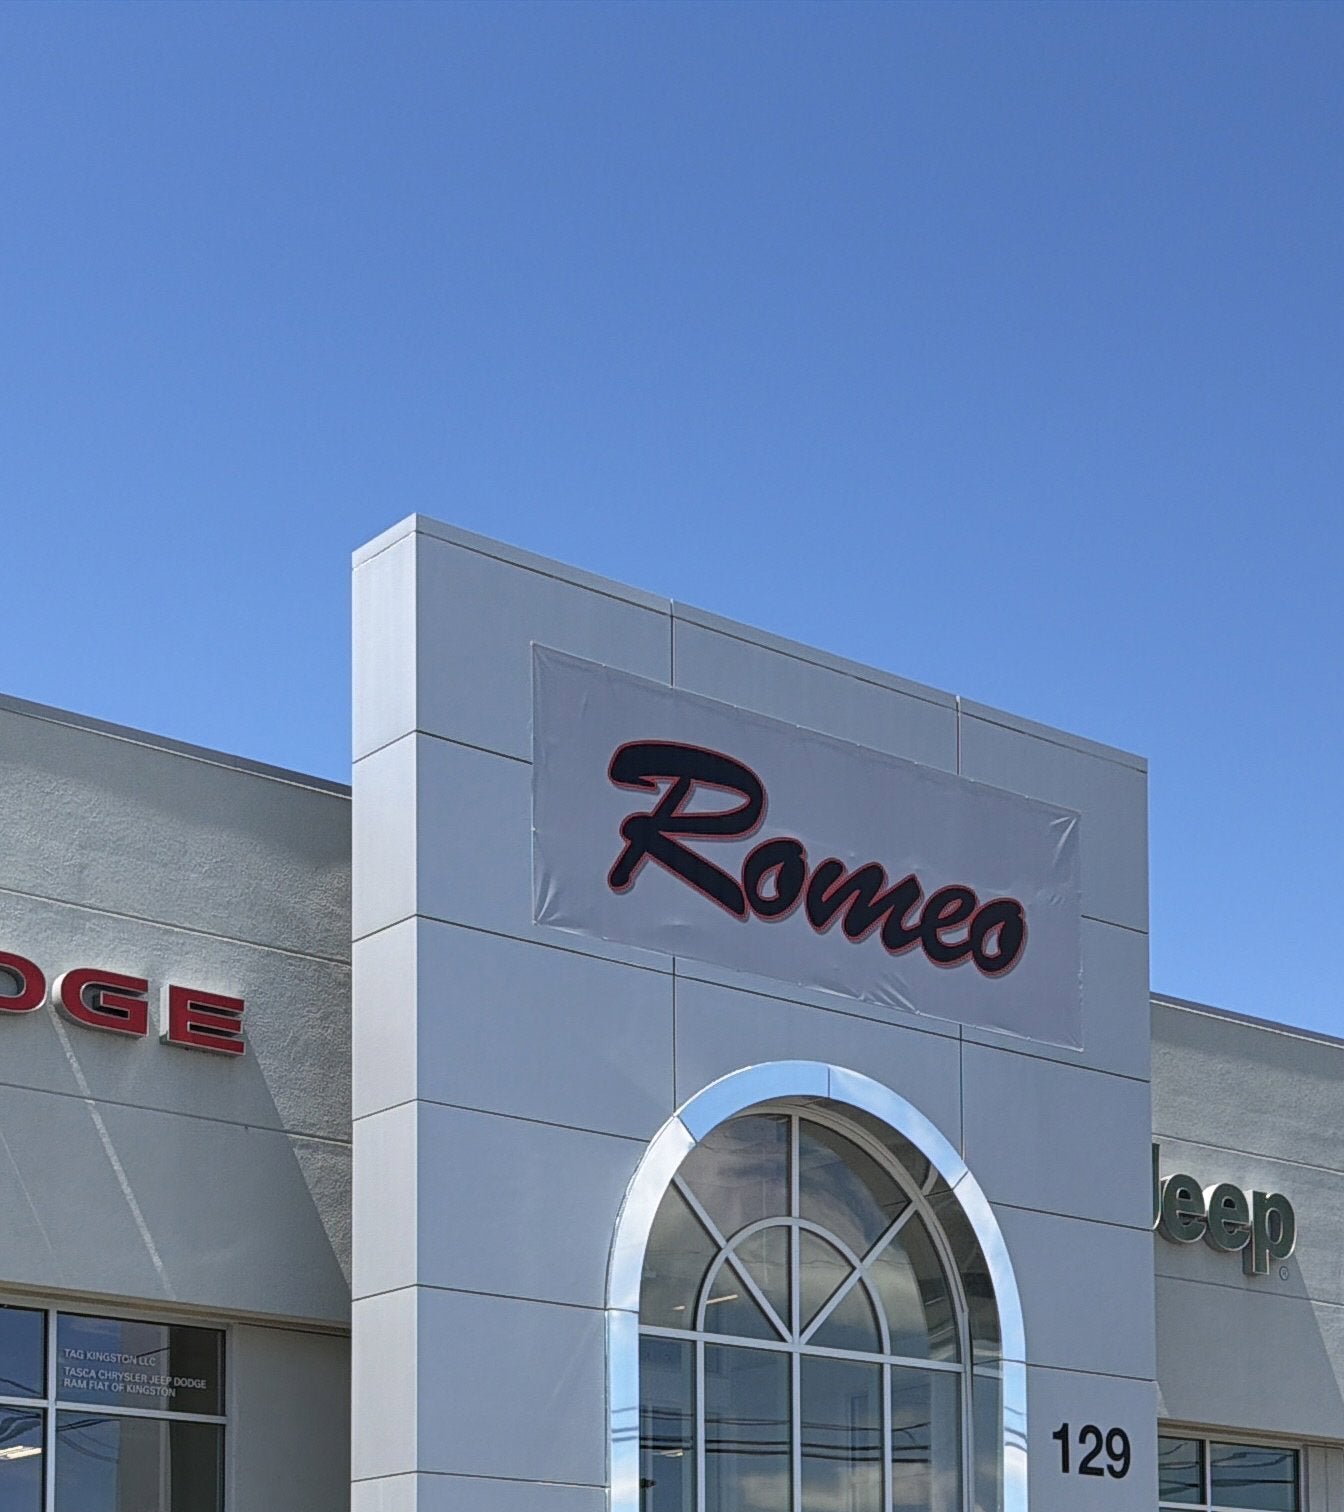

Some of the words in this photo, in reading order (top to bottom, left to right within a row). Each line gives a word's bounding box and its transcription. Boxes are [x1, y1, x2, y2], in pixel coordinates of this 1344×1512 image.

[608, 740, 1027, 978] Romeo
[64, 1349, 84, 1360] TAG
[86, 1352, 137, 1366] KINGSTON
[139, 1356, 156, 1367] LLC
[64, 1366, 96, 1379] TASCA
[98, 1370, 148, 1384] CHRYSLER
[149, 1374, 172, 1386] JEEP
[174, 1376, 207, 1389] DODGE
[64, 1378, 87, 1389] RAM
[89, 1380, 109, 1391] FIAT
[111, 1382, 124, 1392] OF
[126, 1385, 176, 1398] KINGSTON
[1052, 1422, 1131, 1479] 129
